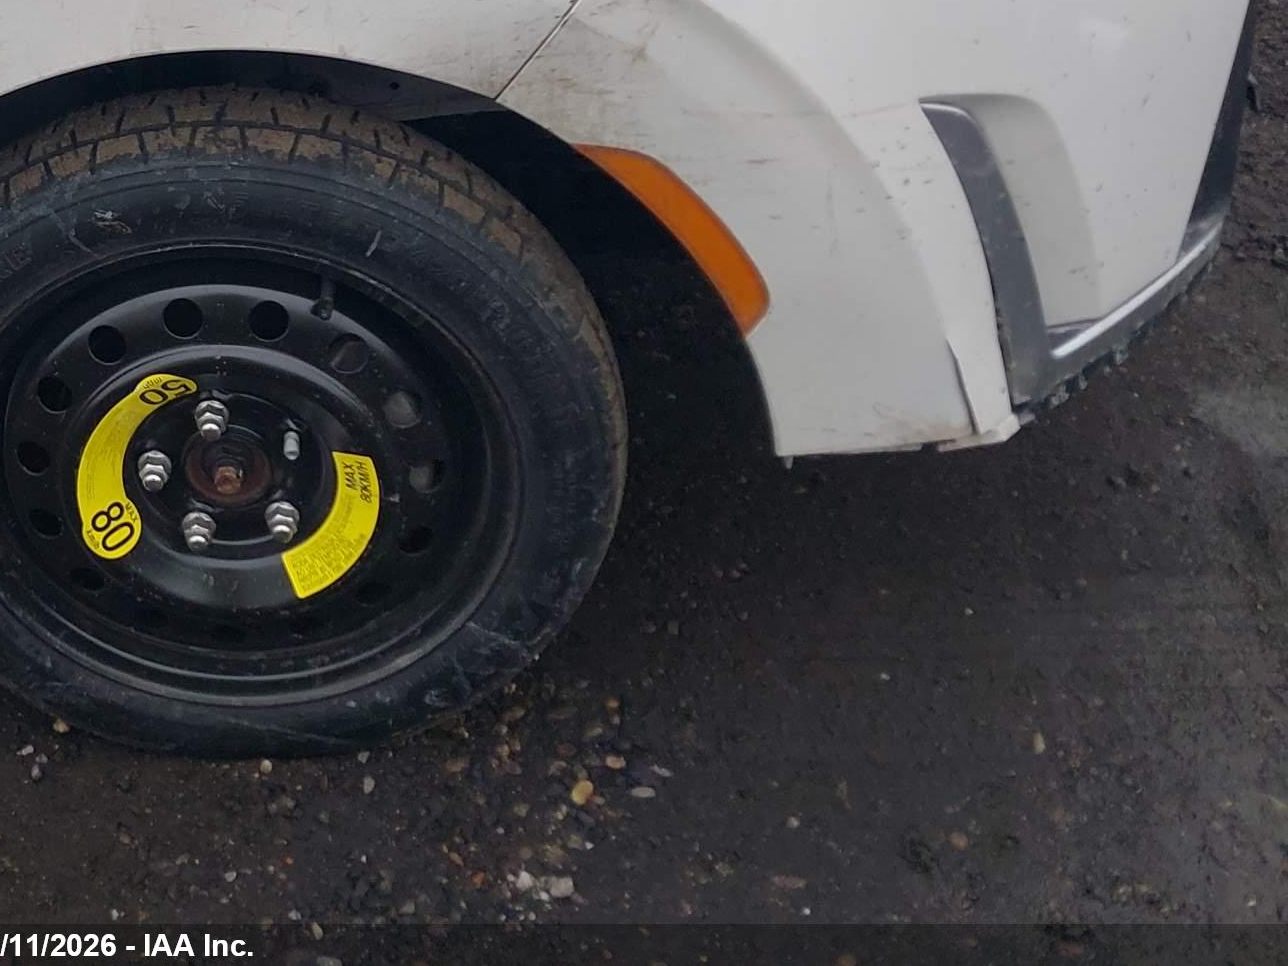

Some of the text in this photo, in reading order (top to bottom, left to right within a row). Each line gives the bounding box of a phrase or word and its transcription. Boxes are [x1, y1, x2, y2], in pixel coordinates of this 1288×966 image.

[139, 379, 193, 406] 50
[342, 461, 358, 491] MAX
[91, 501, 135, 552] 80
